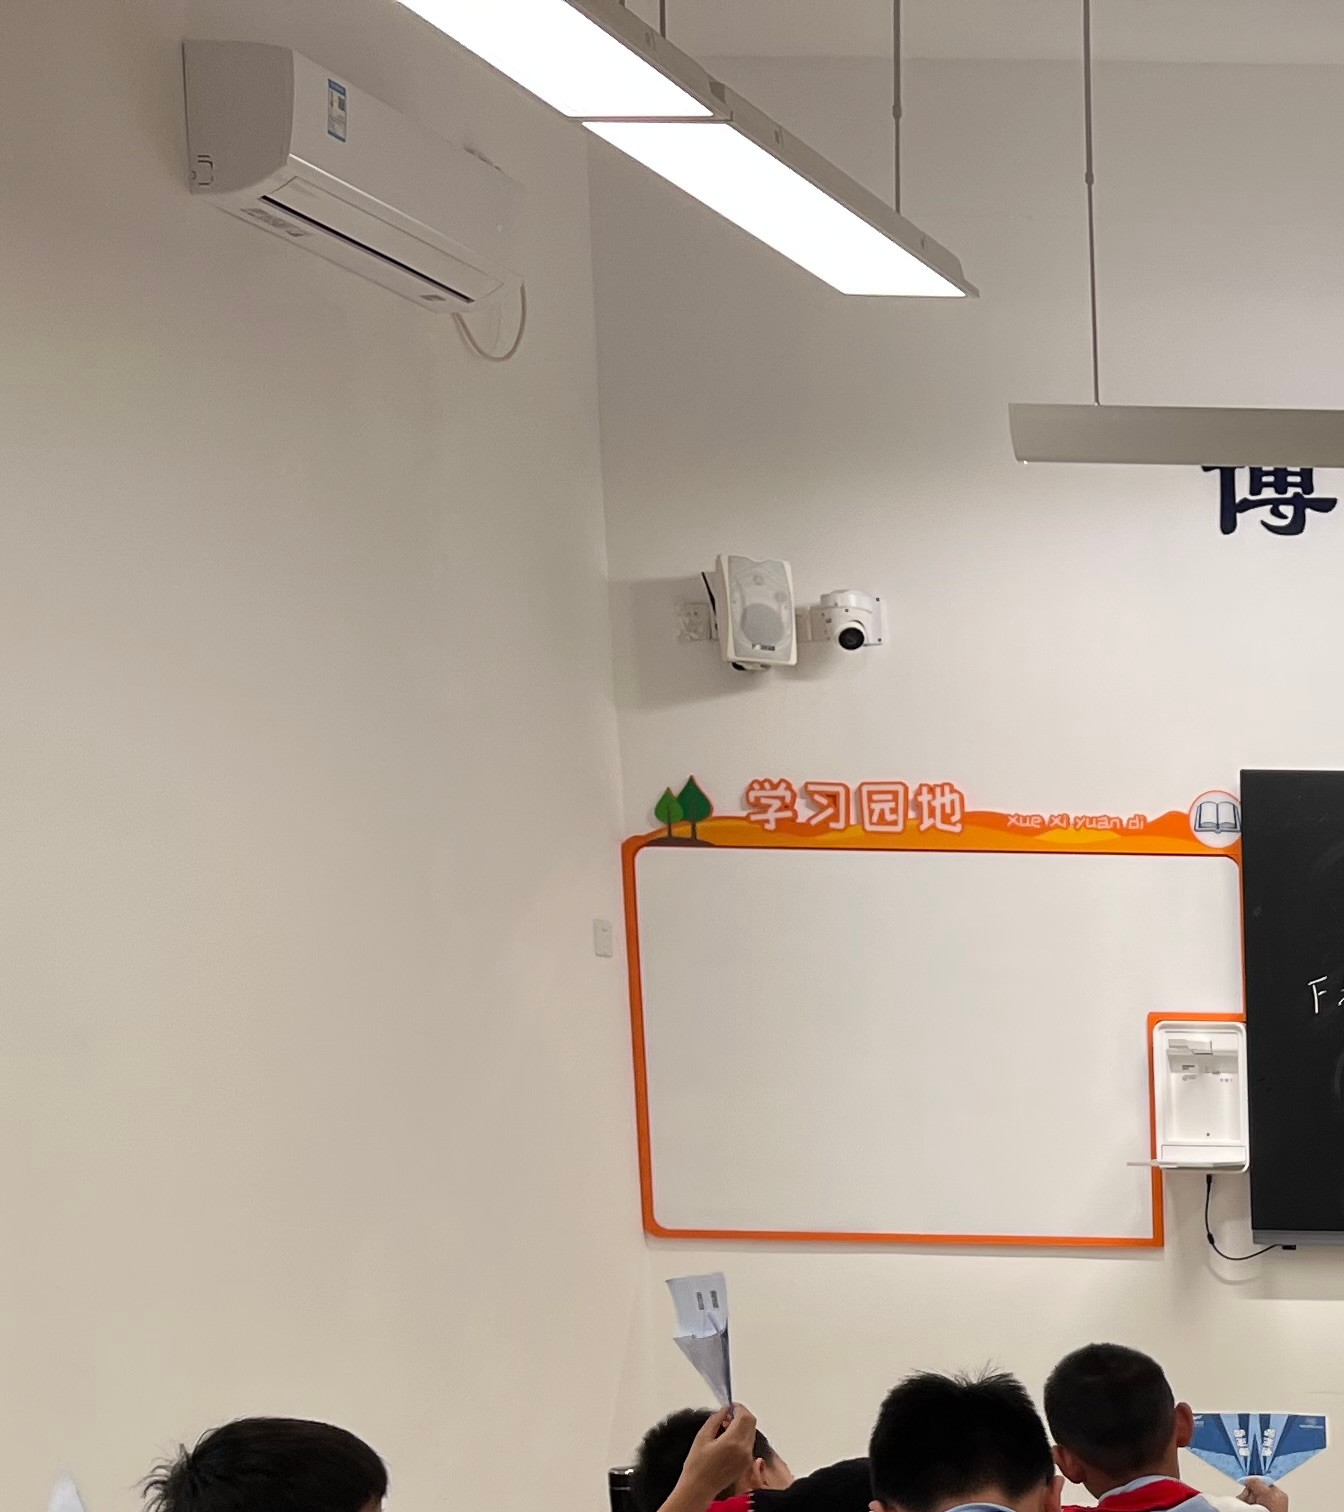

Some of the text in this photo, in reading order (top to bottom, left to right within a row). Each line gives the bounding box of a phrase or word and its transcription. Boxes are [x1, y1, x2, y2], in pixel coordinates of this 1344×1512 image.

[748, 780, 963, 833] 学习园地
[1007, 813, 1146, 830] xue xi yuan di
[1308, 975, 1328, 1014] F
